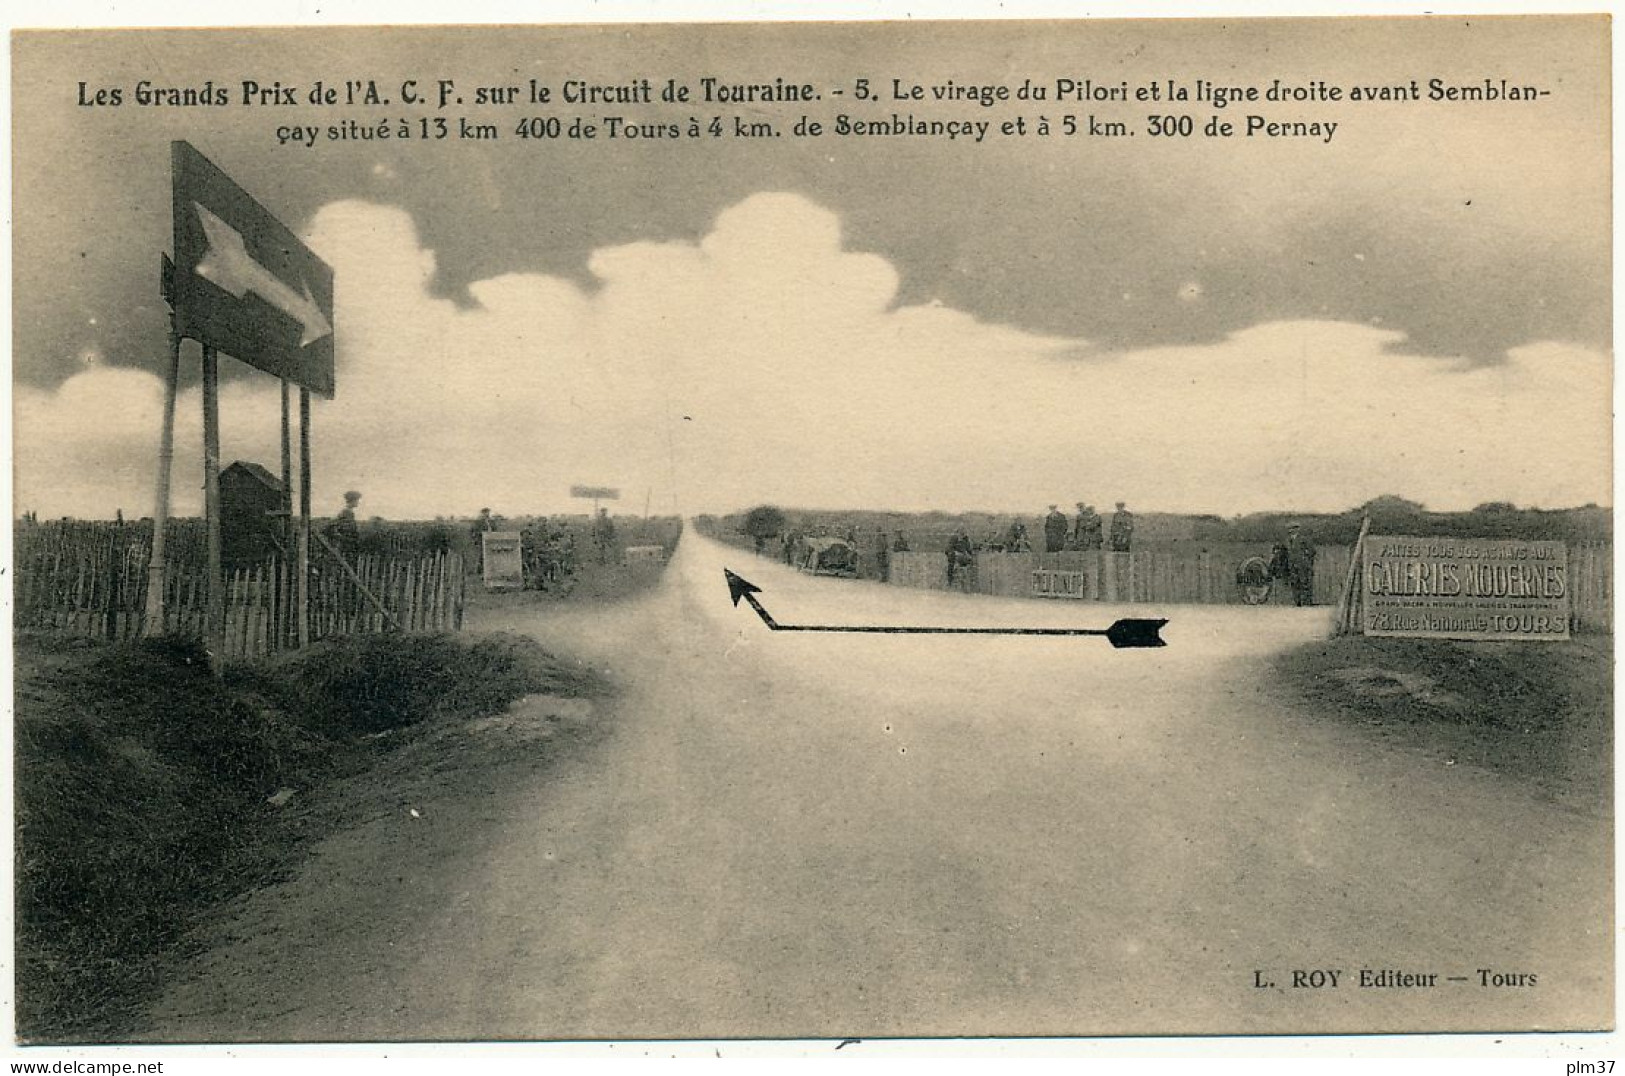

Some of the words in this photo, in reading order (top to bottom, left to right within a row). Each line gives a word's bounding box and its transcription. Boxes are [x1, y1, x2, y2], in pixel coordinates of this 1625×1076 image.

[1426, 545, 1453, 559] TOUS
[1368, 561, 1460, 597] GALERIES
[1465, 563, 1565, 598] MODERNES
[1491, 616, 1565, 634] TOURS
